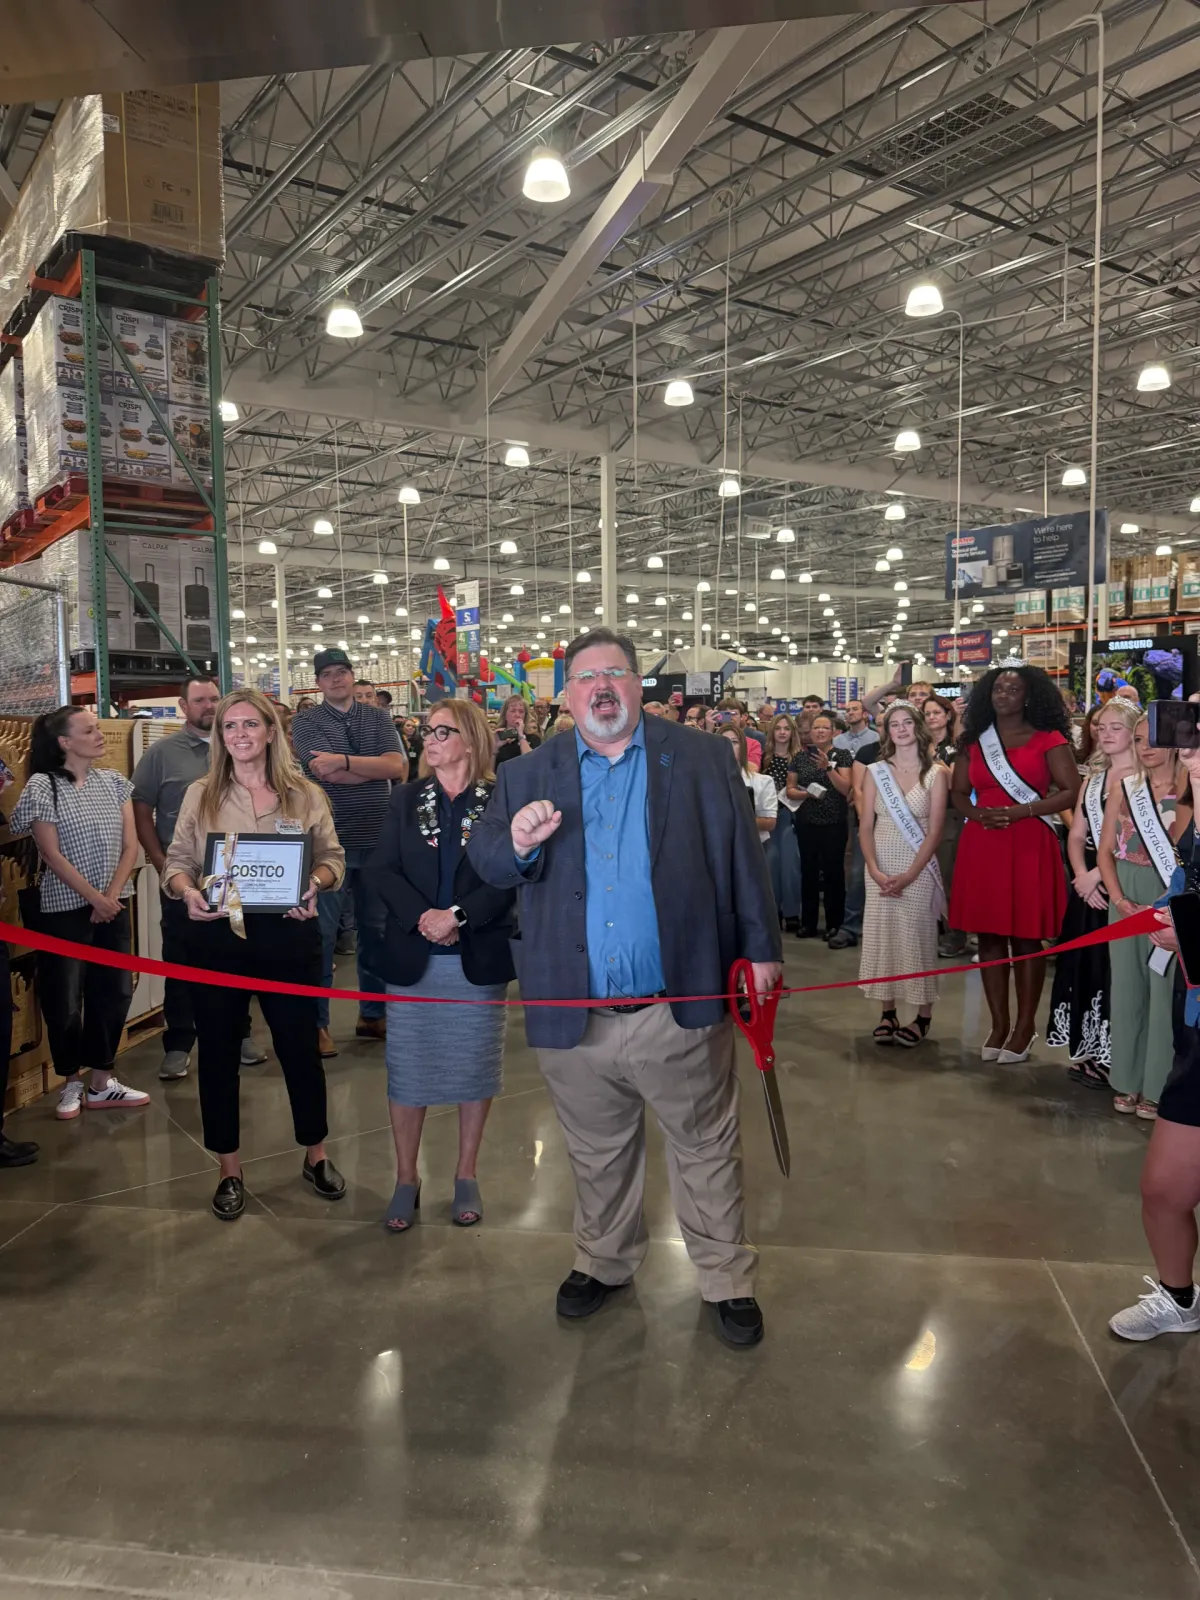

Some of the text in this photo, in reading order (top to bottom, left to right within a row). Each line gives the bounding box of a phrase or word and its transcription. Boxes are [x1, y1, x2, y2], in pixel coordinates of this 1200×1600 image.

[142, 542, 168, 550] CALPAK
[1042, 534, 1059, 542] help
[1108, 639, 1153, 650] SAMSUNG
[990, 749, 1032, 802] Miss Syracus
[880, 774, 918, 838] Teen Syracuse
[1089, 799, 1101, 836] Syracu
[1134, 789, 1173, 872] Miss Syracuse
[231, 864, 284, 878] COSTCO
